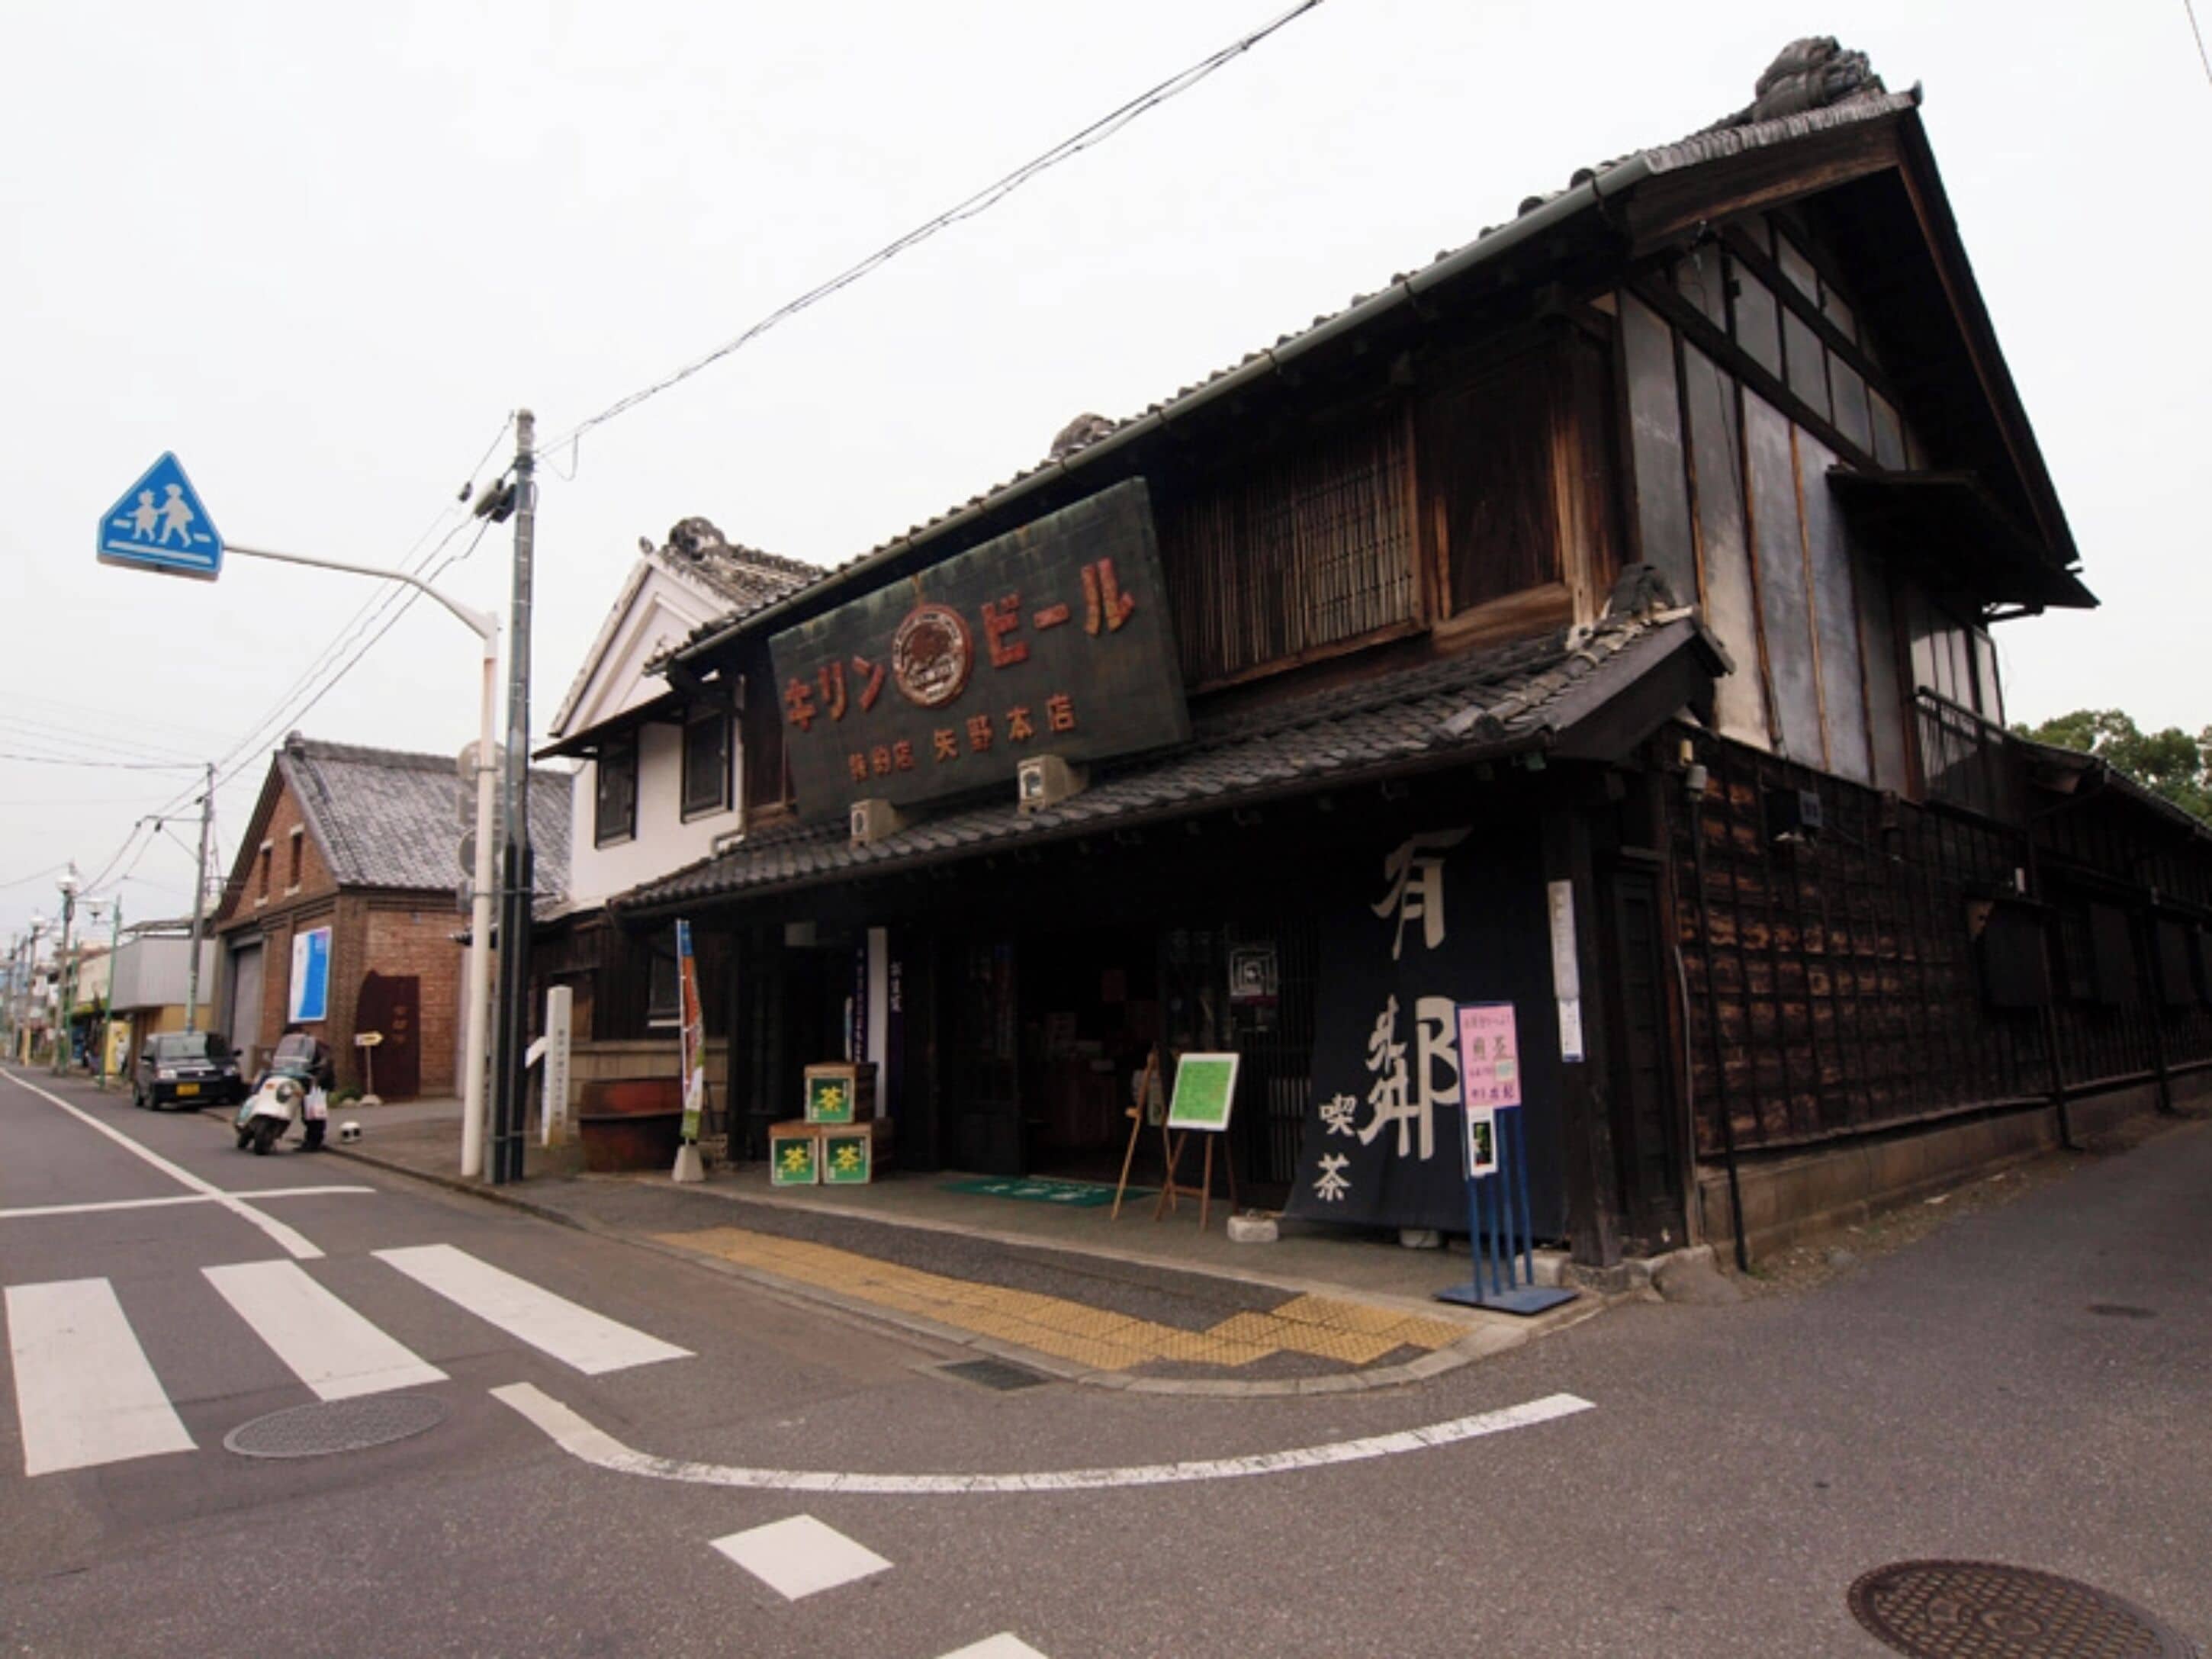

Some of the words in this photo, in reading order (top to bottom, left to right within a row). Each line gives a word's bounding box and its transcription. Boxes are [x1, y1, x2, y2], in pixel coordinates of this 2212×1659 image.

[783, 654, 887, 731] キリン
[980, 556, 1136, 669] ビール
[932, 692, 1077, 763] 矢野本店
[818, 1085, 843, 1112] 茶
[783, 1145, 809, 1172] 茶
[832, 1144, 860, 1172] 茶
[1312, 1092, 1358, 1201] 喫茶
